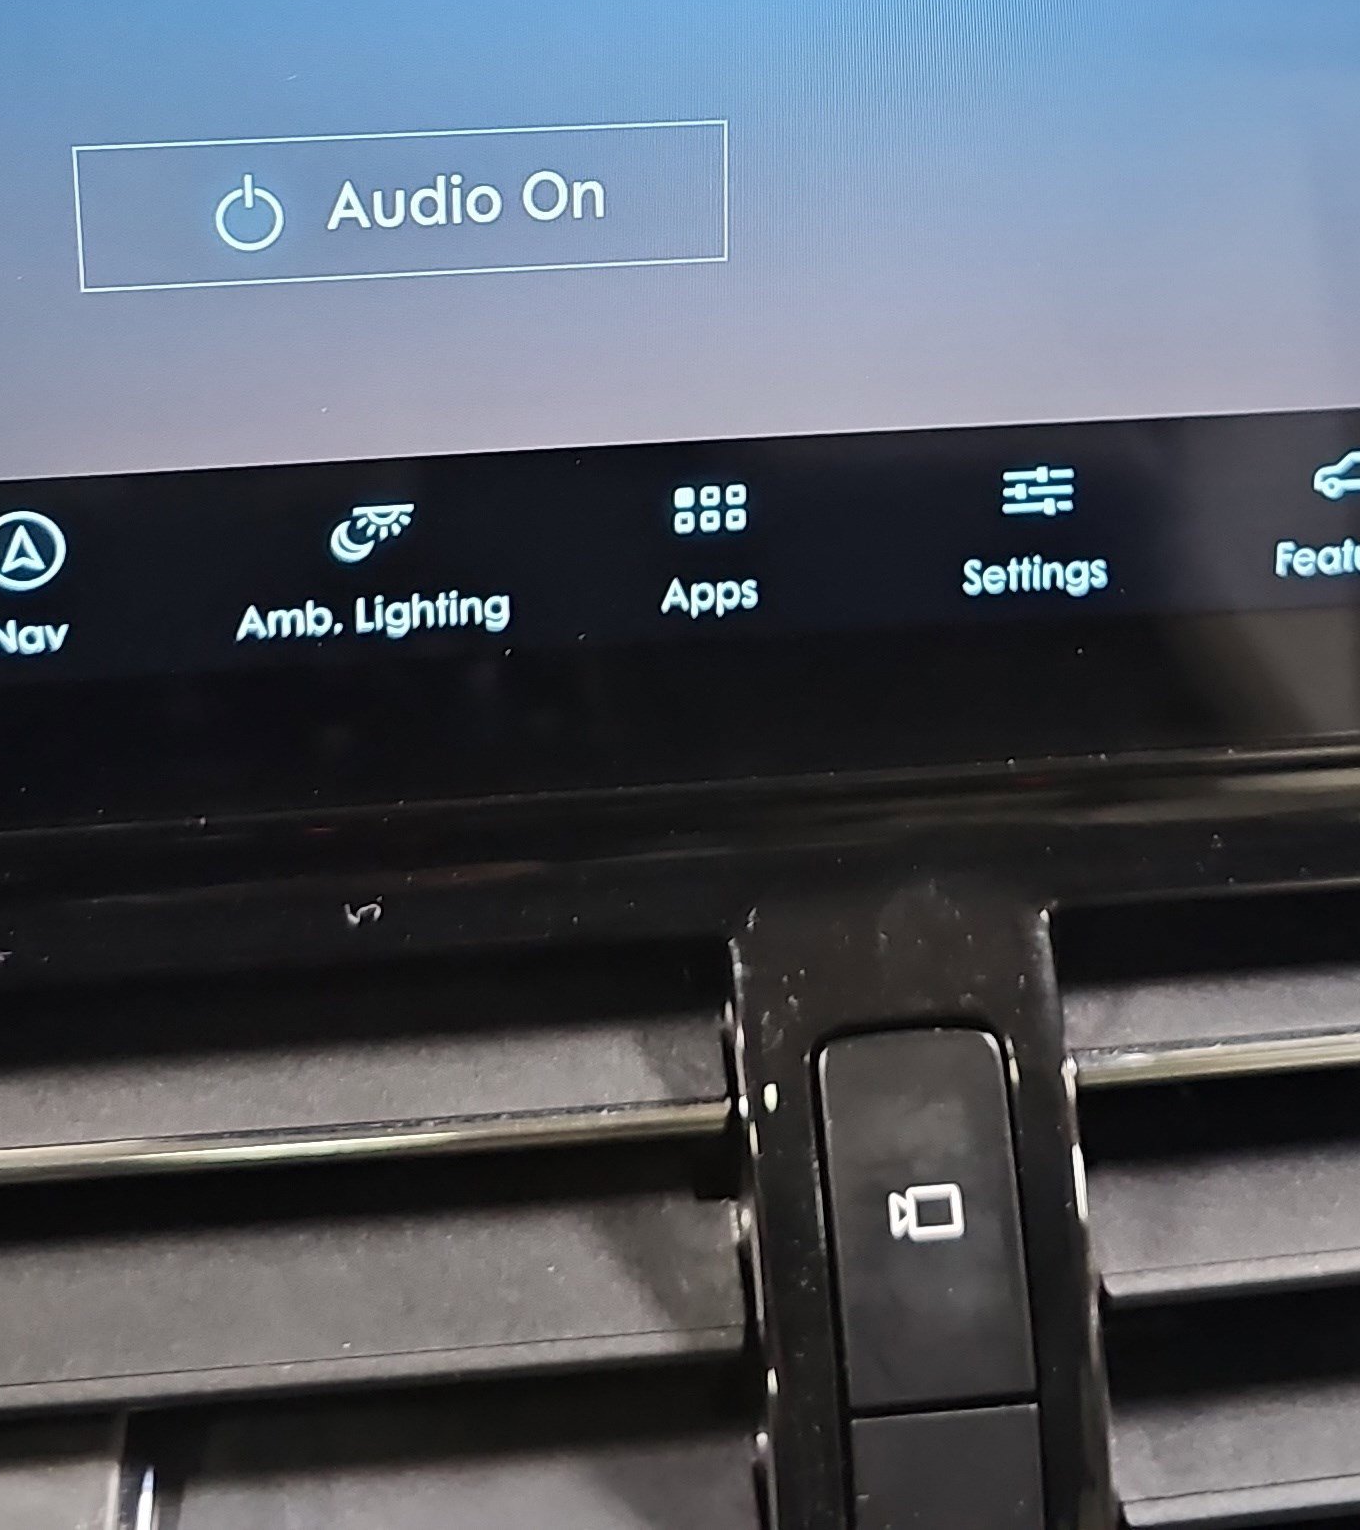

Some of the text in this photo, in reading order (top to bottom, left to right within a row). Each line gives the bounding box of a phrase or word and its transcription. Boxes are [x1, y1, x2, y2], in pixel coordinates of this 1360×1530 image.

[327, 170, 604, 230] Audio On
[660, 577, 759, 619] Apps
[961, 554, 1109, 597] Settings
[235, 589, 511, 642] Amb. Lighting
